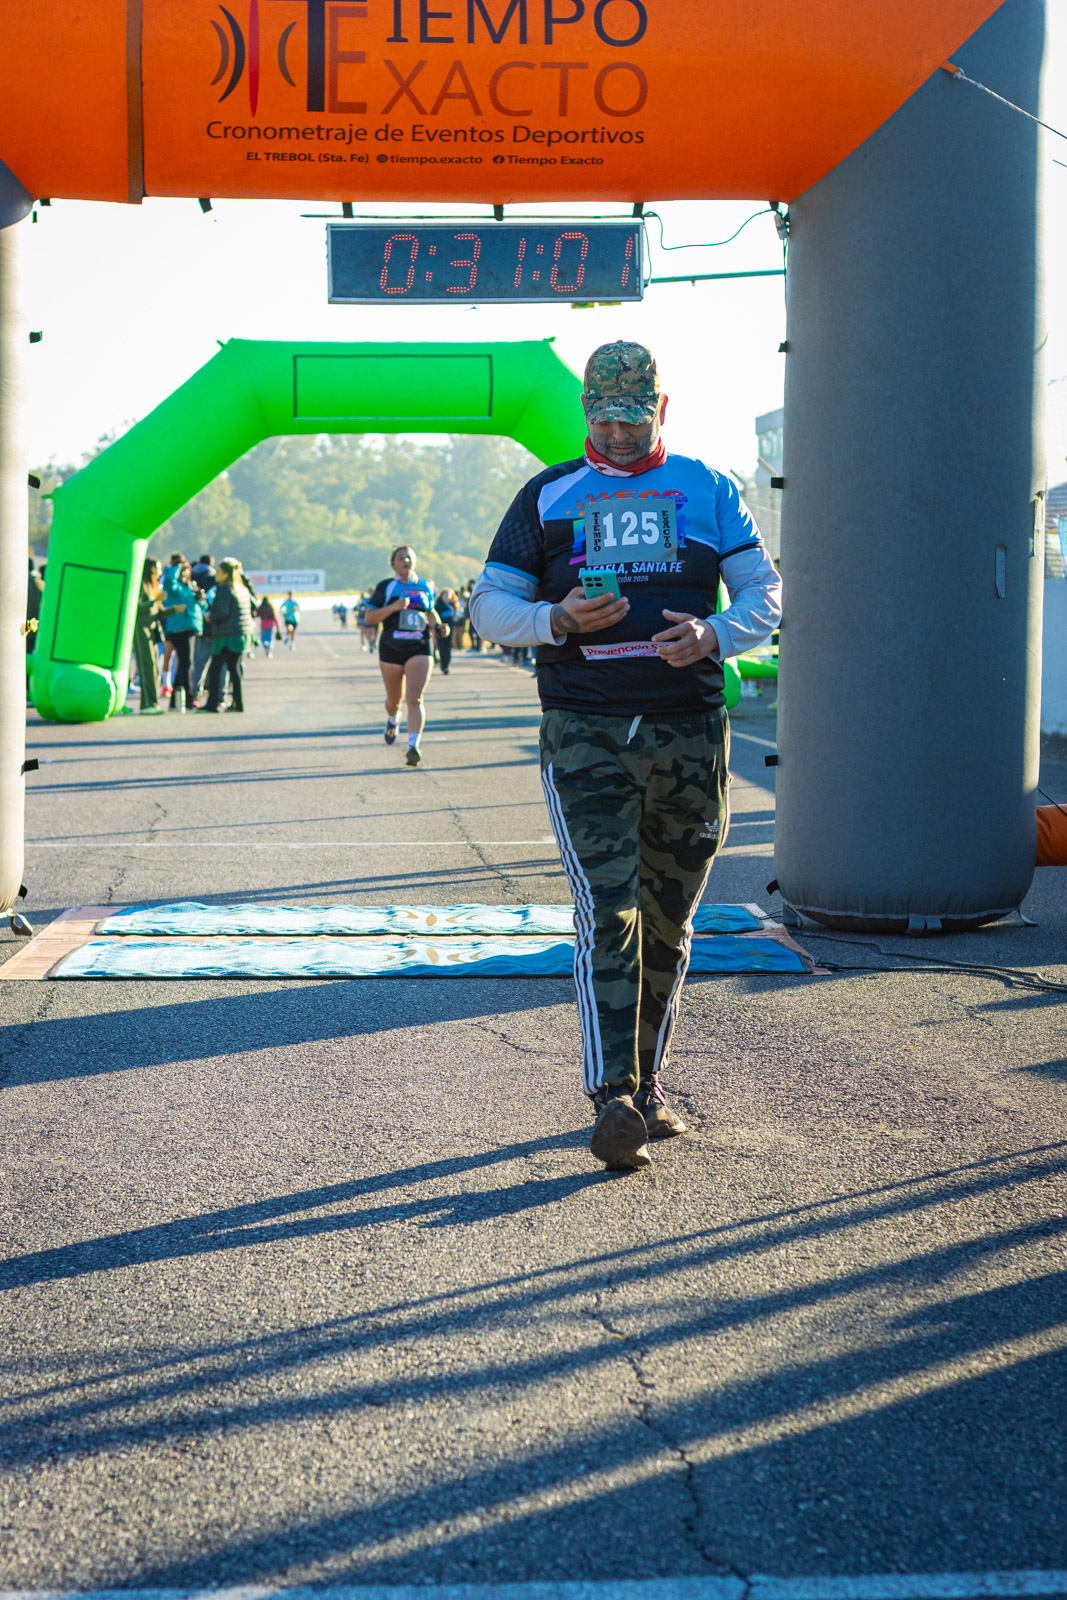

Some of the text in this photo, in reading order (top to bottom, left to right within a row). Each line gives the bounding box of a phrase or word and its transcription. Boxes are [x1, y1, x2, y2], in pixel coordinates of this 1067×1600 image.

[206, 120, 645, 147] Cronometraje de Eventos Deportivos
[246, 151, 370, 164] EL TREBOL (Sta. Fe)
[390, 153, 483, 165] tiempo.exacto
[507, 155, 604, 166] Tiempo Exacto
[592, 511, 602, 552] TIEMPO
[602, 511, 660, 548] 125
[661, 510, 672, 549] EXACTO
[631, 561, 670, 573] SANTA
[669, 561, 683, 573] FE
